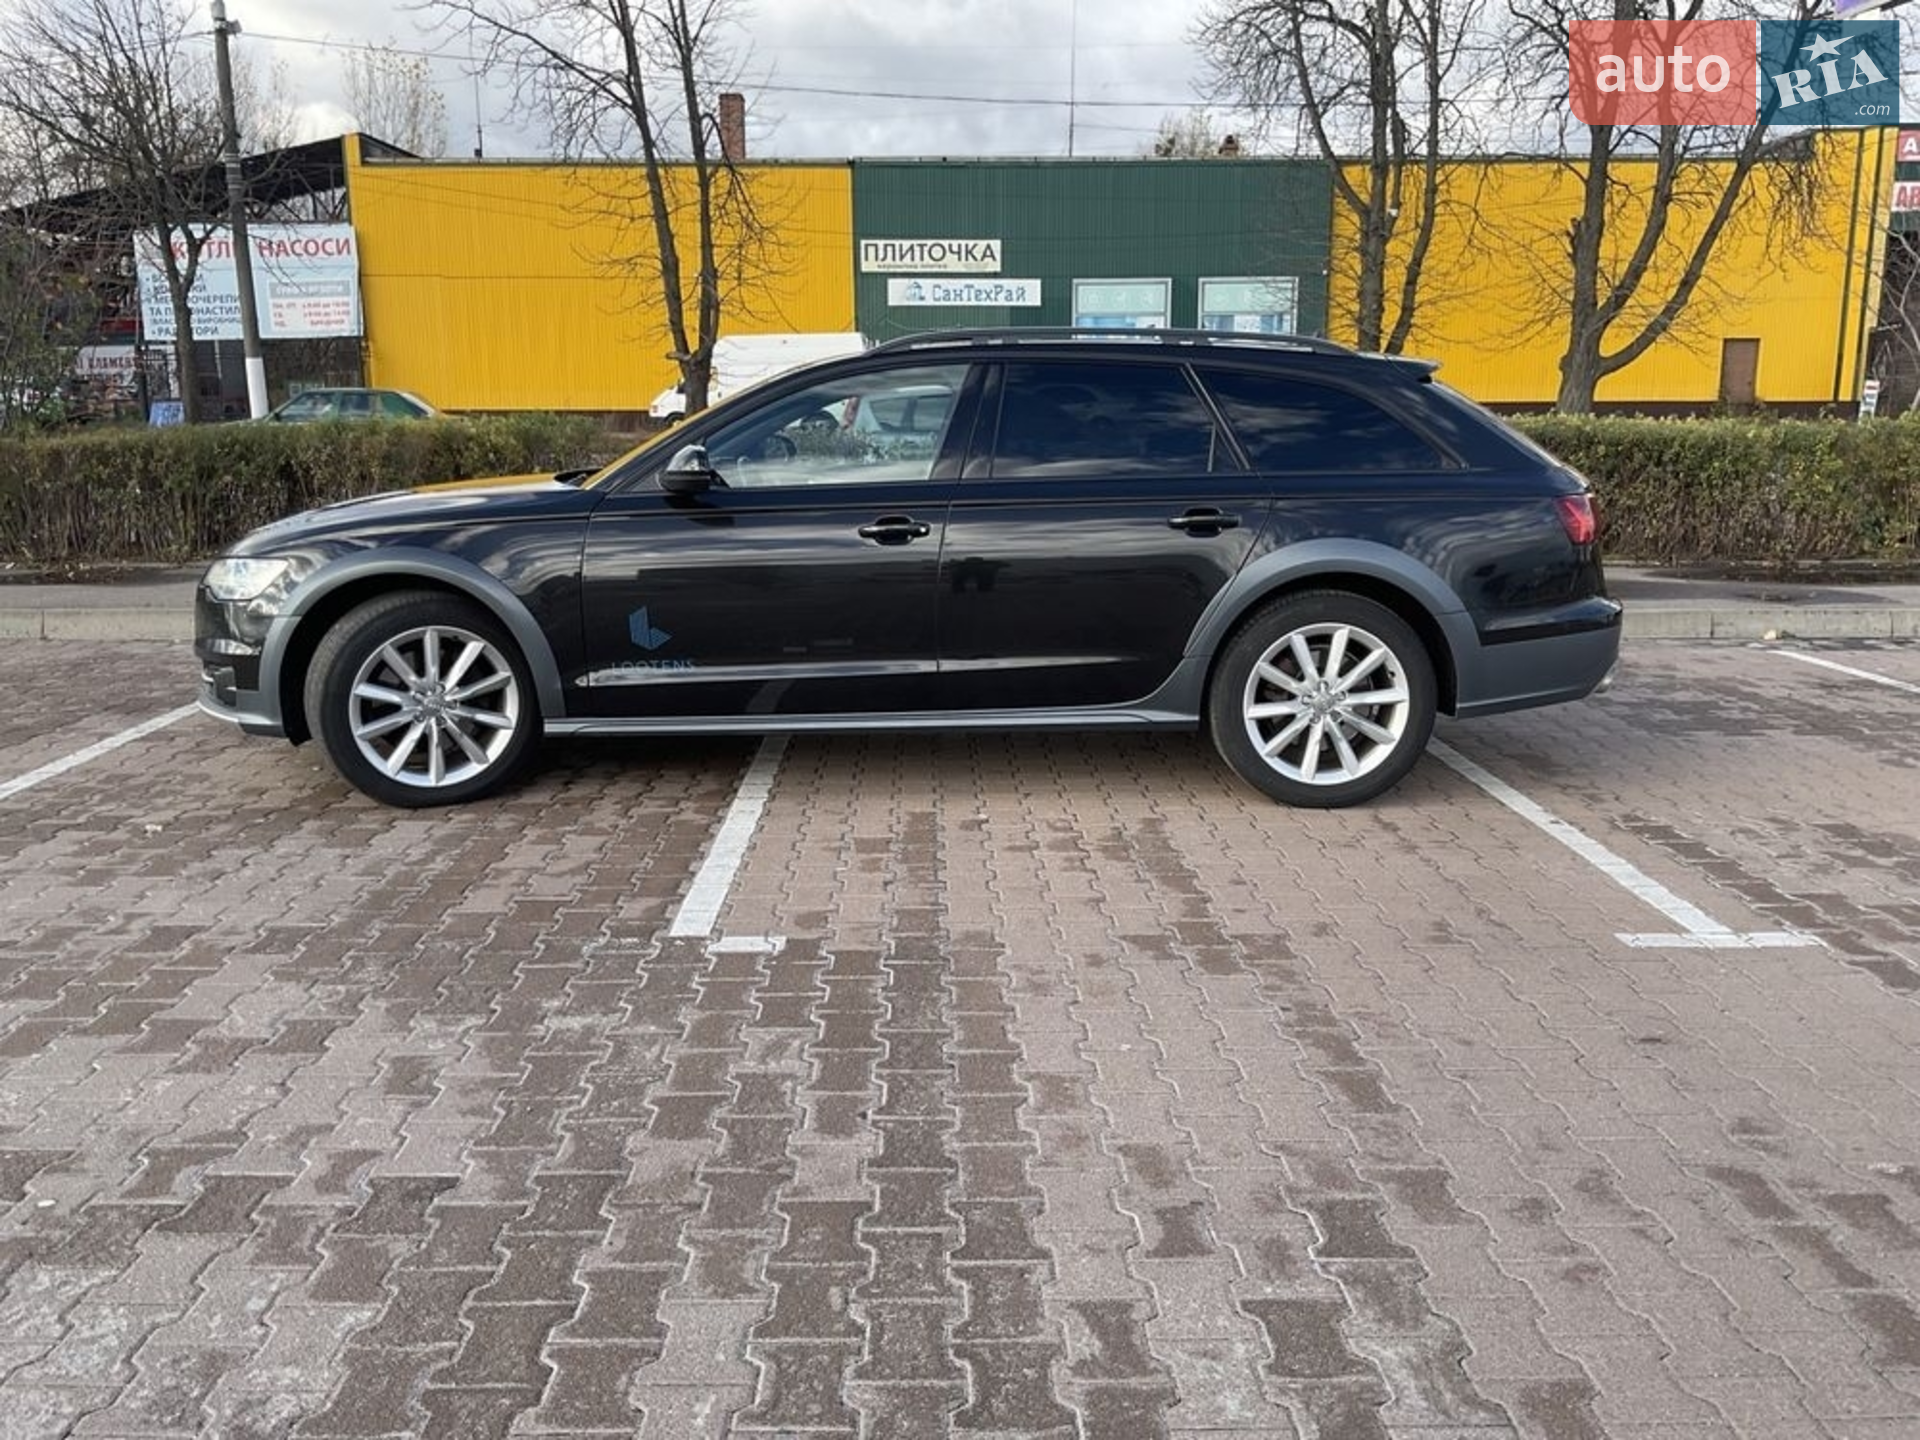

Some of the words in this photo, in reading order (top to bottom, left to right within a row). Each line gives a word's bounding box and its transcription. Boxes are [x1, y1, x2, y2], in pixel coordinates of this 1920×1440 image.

[170, 239, 236, 259] КТЛ
[258, 238, 351, 257] НАСОСИ
[864, 243, 997, 262] ПЛИТОЧКА
[932, 284, 1026, 302] СанТехРай
